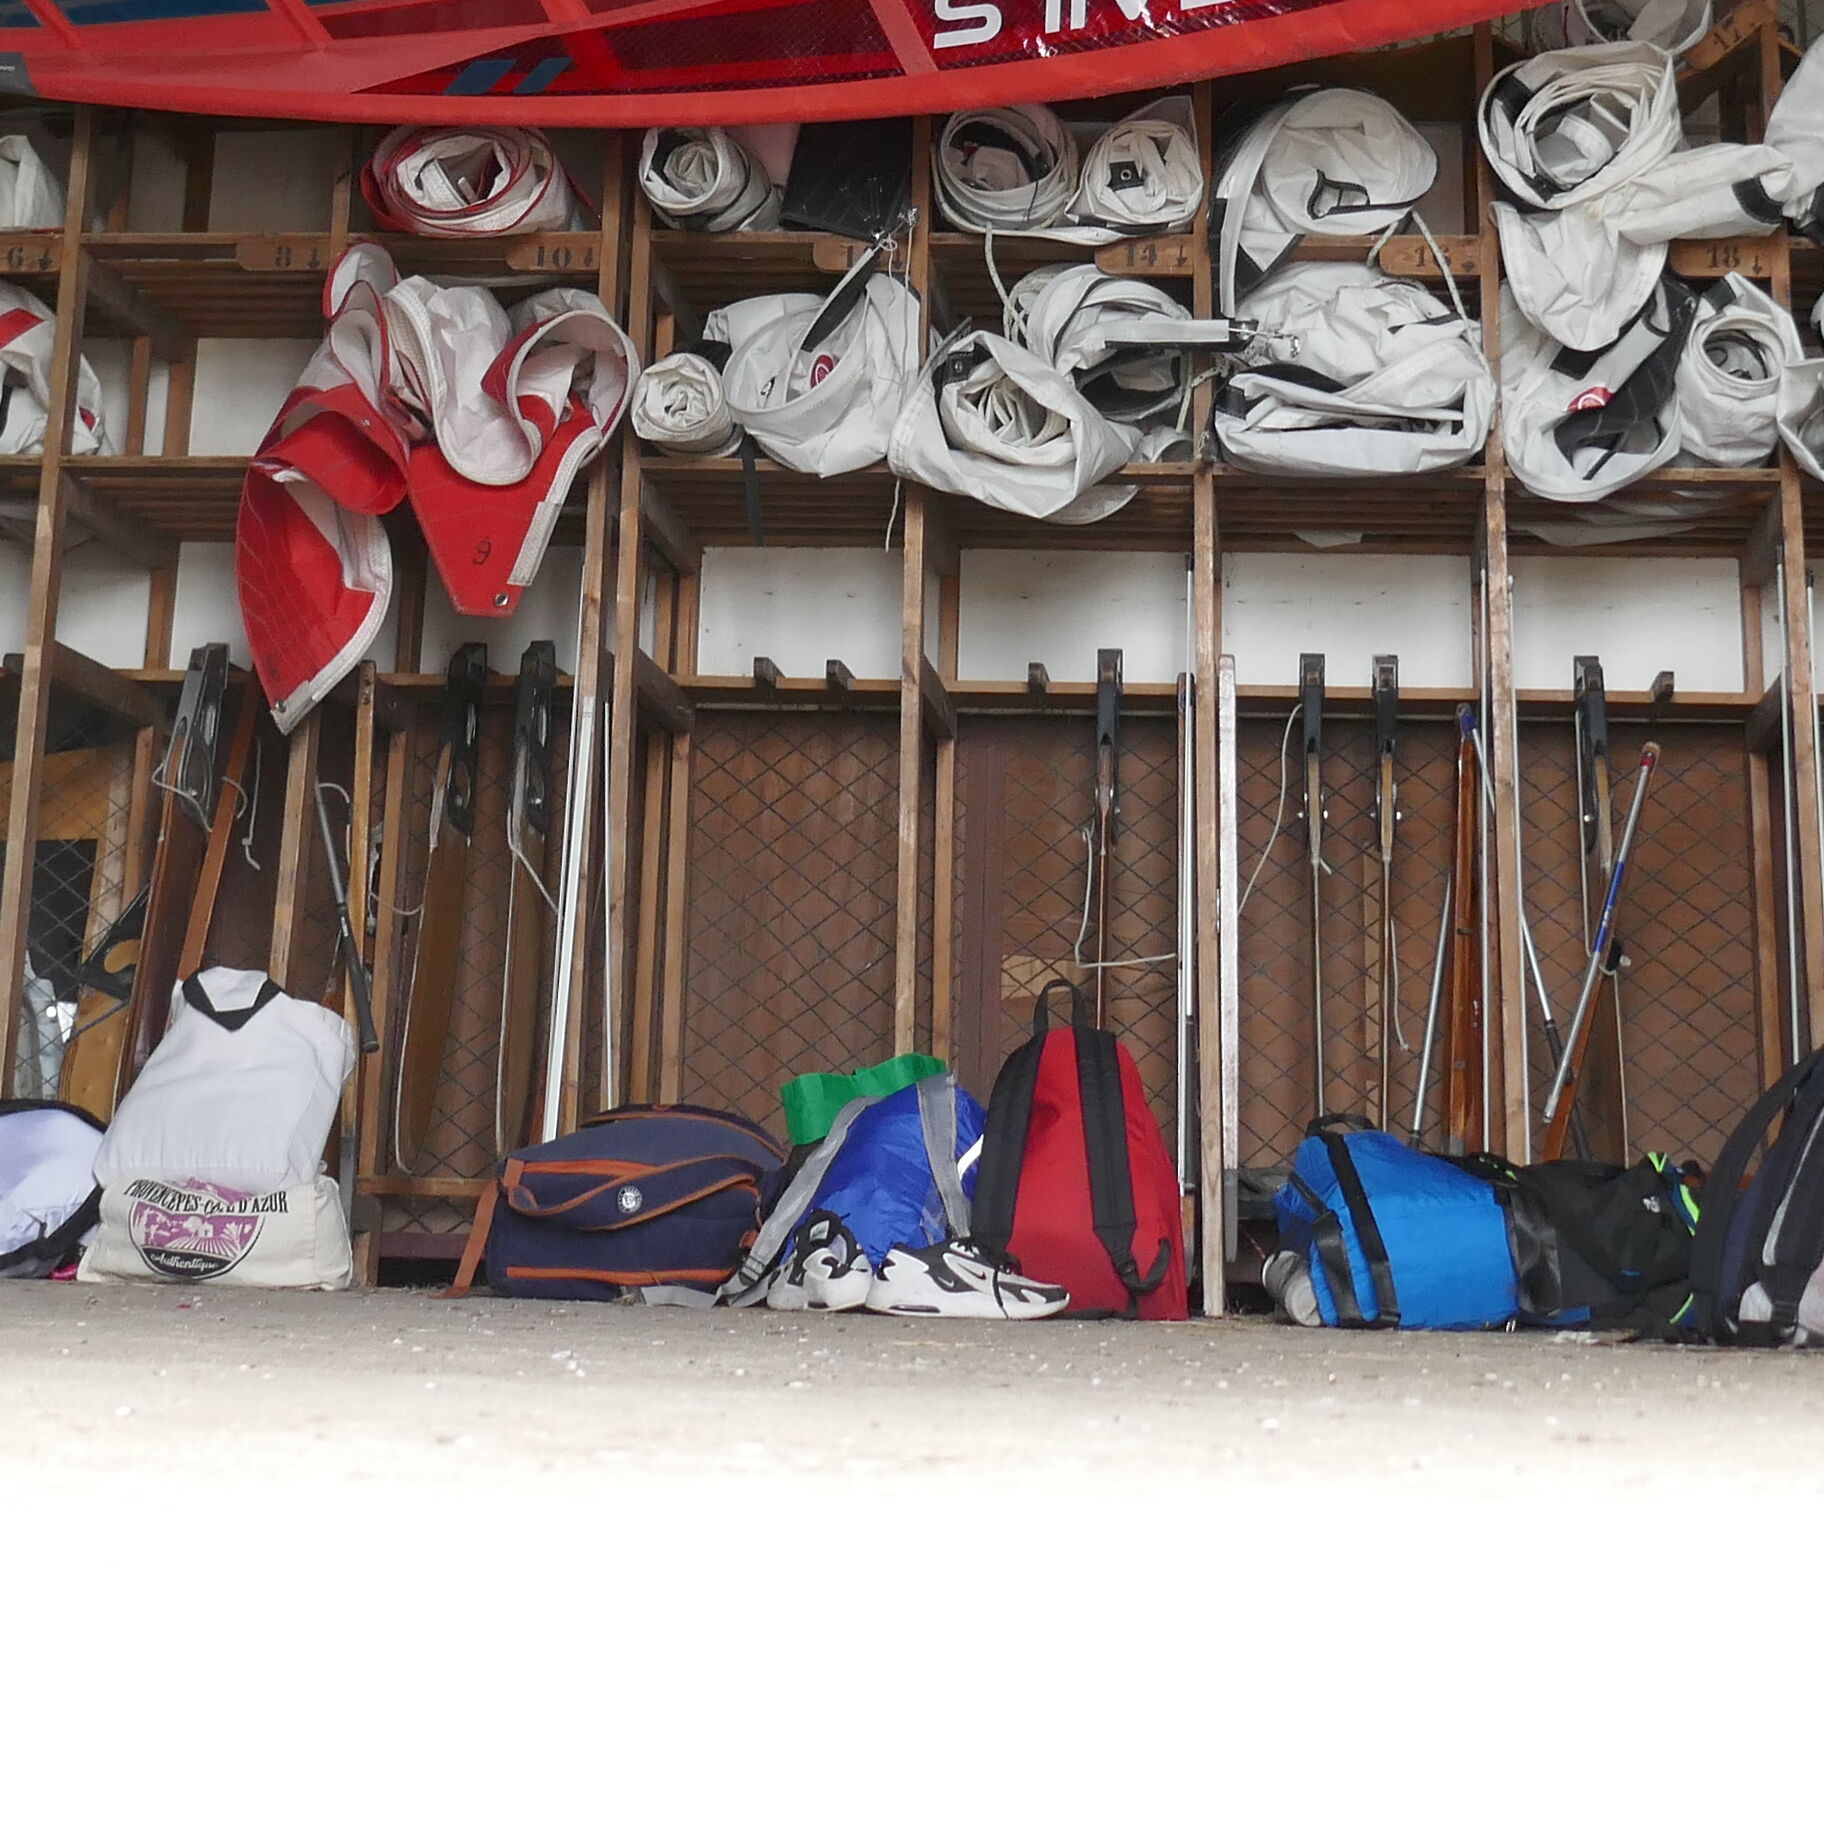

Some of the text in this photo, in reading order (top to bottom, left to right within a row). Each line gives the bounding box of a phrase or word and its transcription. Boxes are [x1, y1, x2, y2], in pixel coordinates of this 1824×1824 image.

[6, 245, 25, 268] 6
[274, 245, 293, 268] 8
[536, 245, 573, 269] 10
[1125, 241, 1159, 268] 14
[1706, 243, 1742, 269] 18
